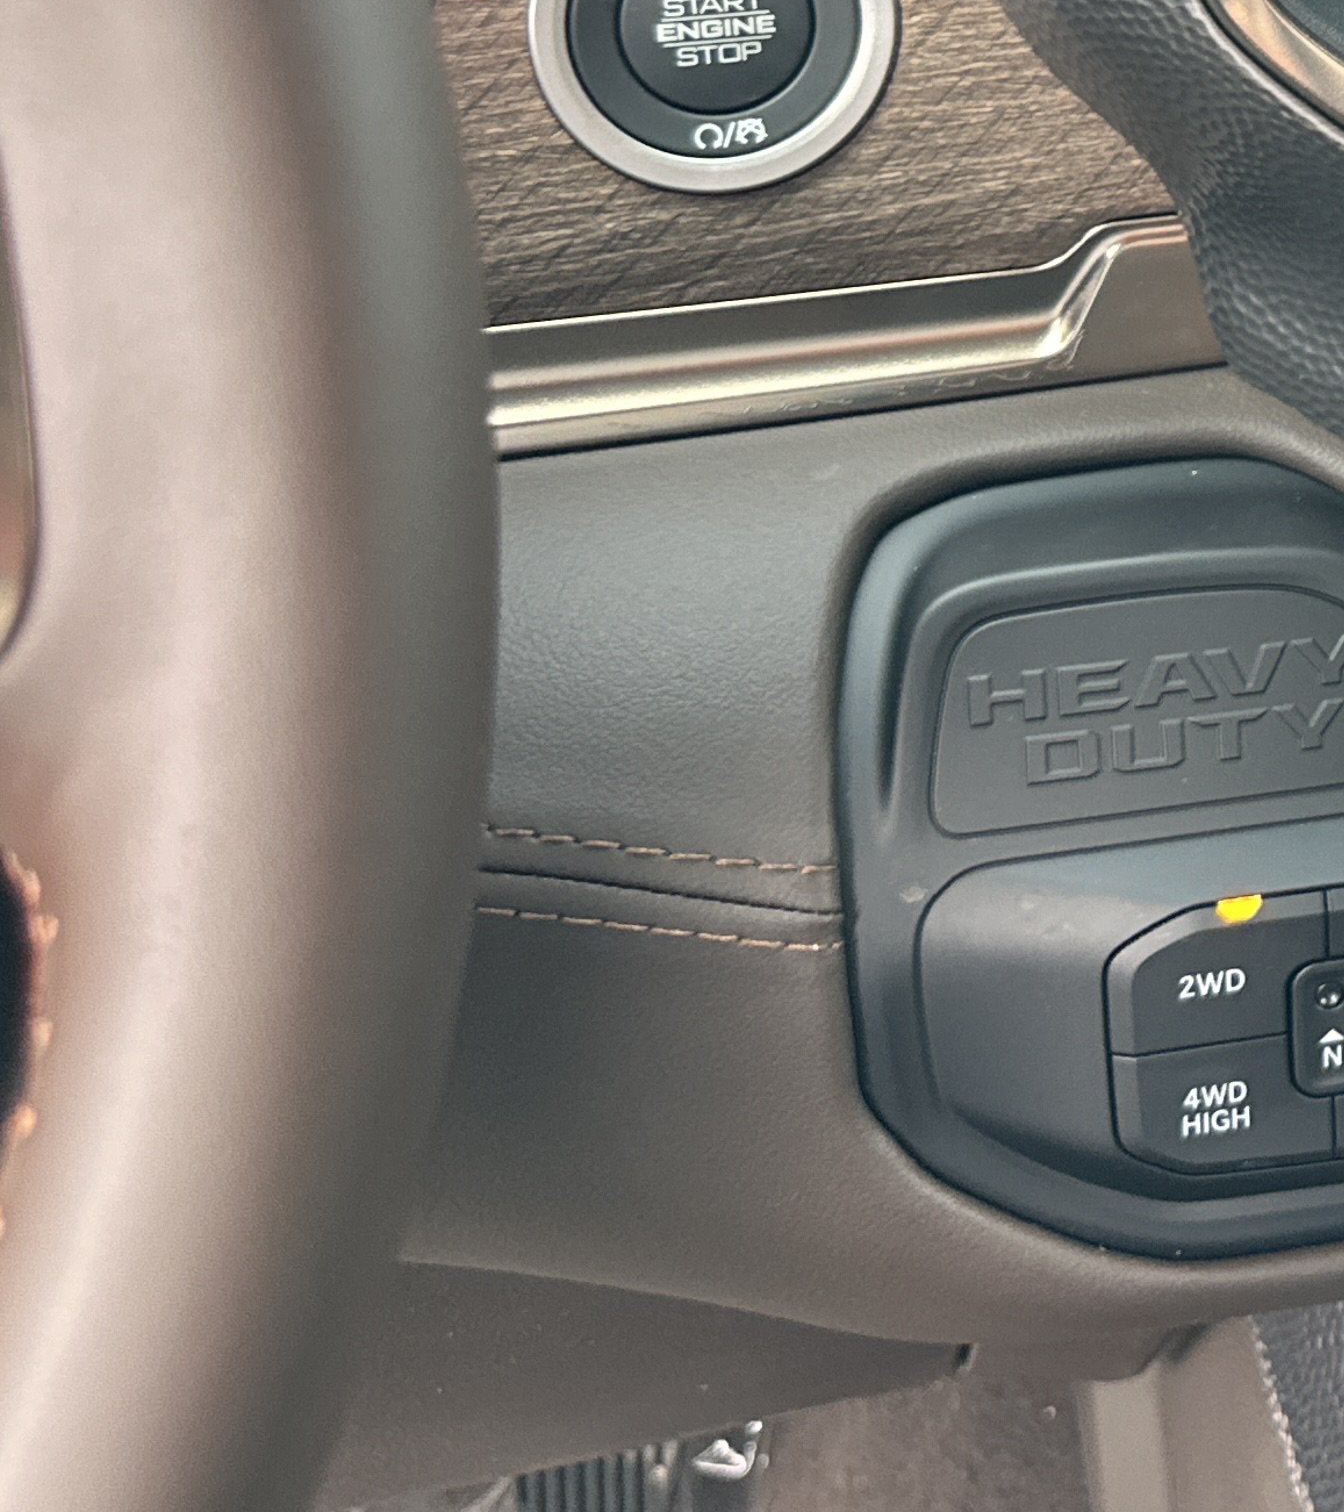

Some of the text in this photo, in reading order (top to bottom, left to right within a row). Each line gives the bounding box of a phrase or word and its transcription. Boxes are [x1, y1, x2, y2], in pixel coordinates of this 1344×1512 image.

[656, 15, 777, 43] ENGINE
[676, 41, 763, 67] STOP
[1026, 698, 1344, 786] DUTY
[1177, 968, 1246, 1000] 2WD
[1322, 1045, 1343, 1069] N
[1182, 1080, 1247, 1110] 4WD
[1181, 1106, 1251, 1138] HIGH
